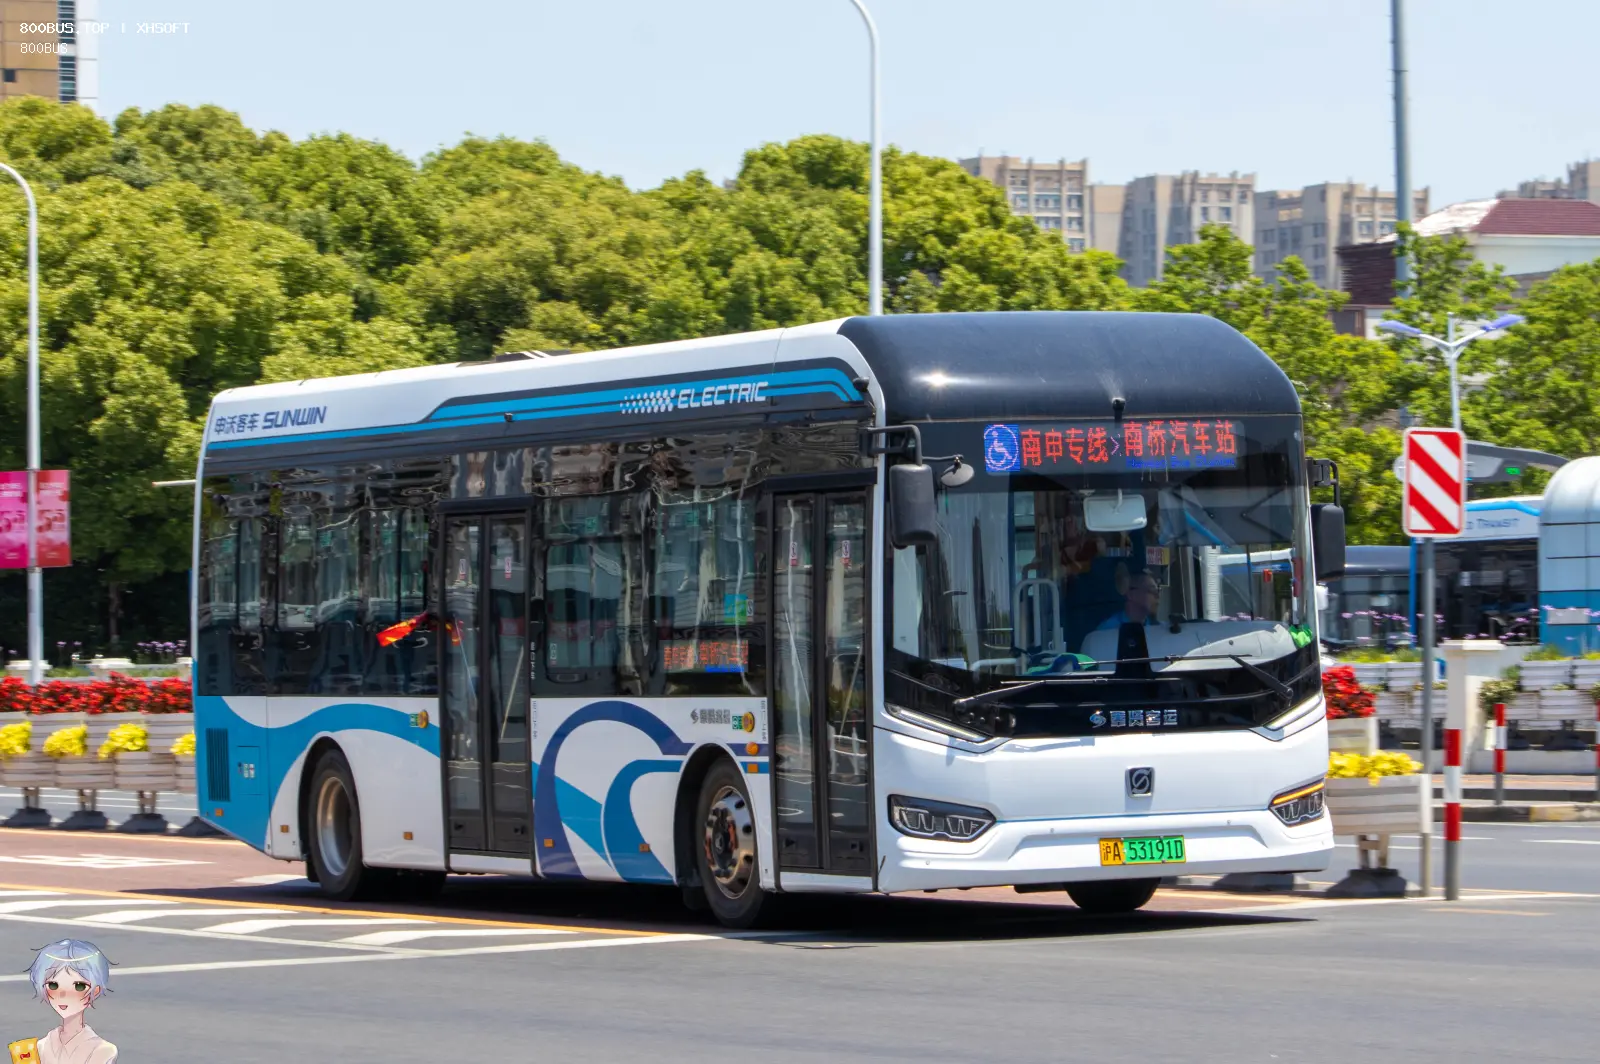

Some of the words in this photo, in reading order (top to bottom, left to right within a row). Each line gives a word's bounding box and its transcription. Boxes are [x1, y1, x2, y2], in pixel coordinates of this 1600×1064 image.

[677, 381, 768, 409] ELECTRIC
[214, 412, 260, 435] 申沃客车
[262, 406, 327, 430] SUNWIN
[1020, 427, 1109, 467] 南申专线
[1123, 420, 1236, 457] 南桥汽车站
